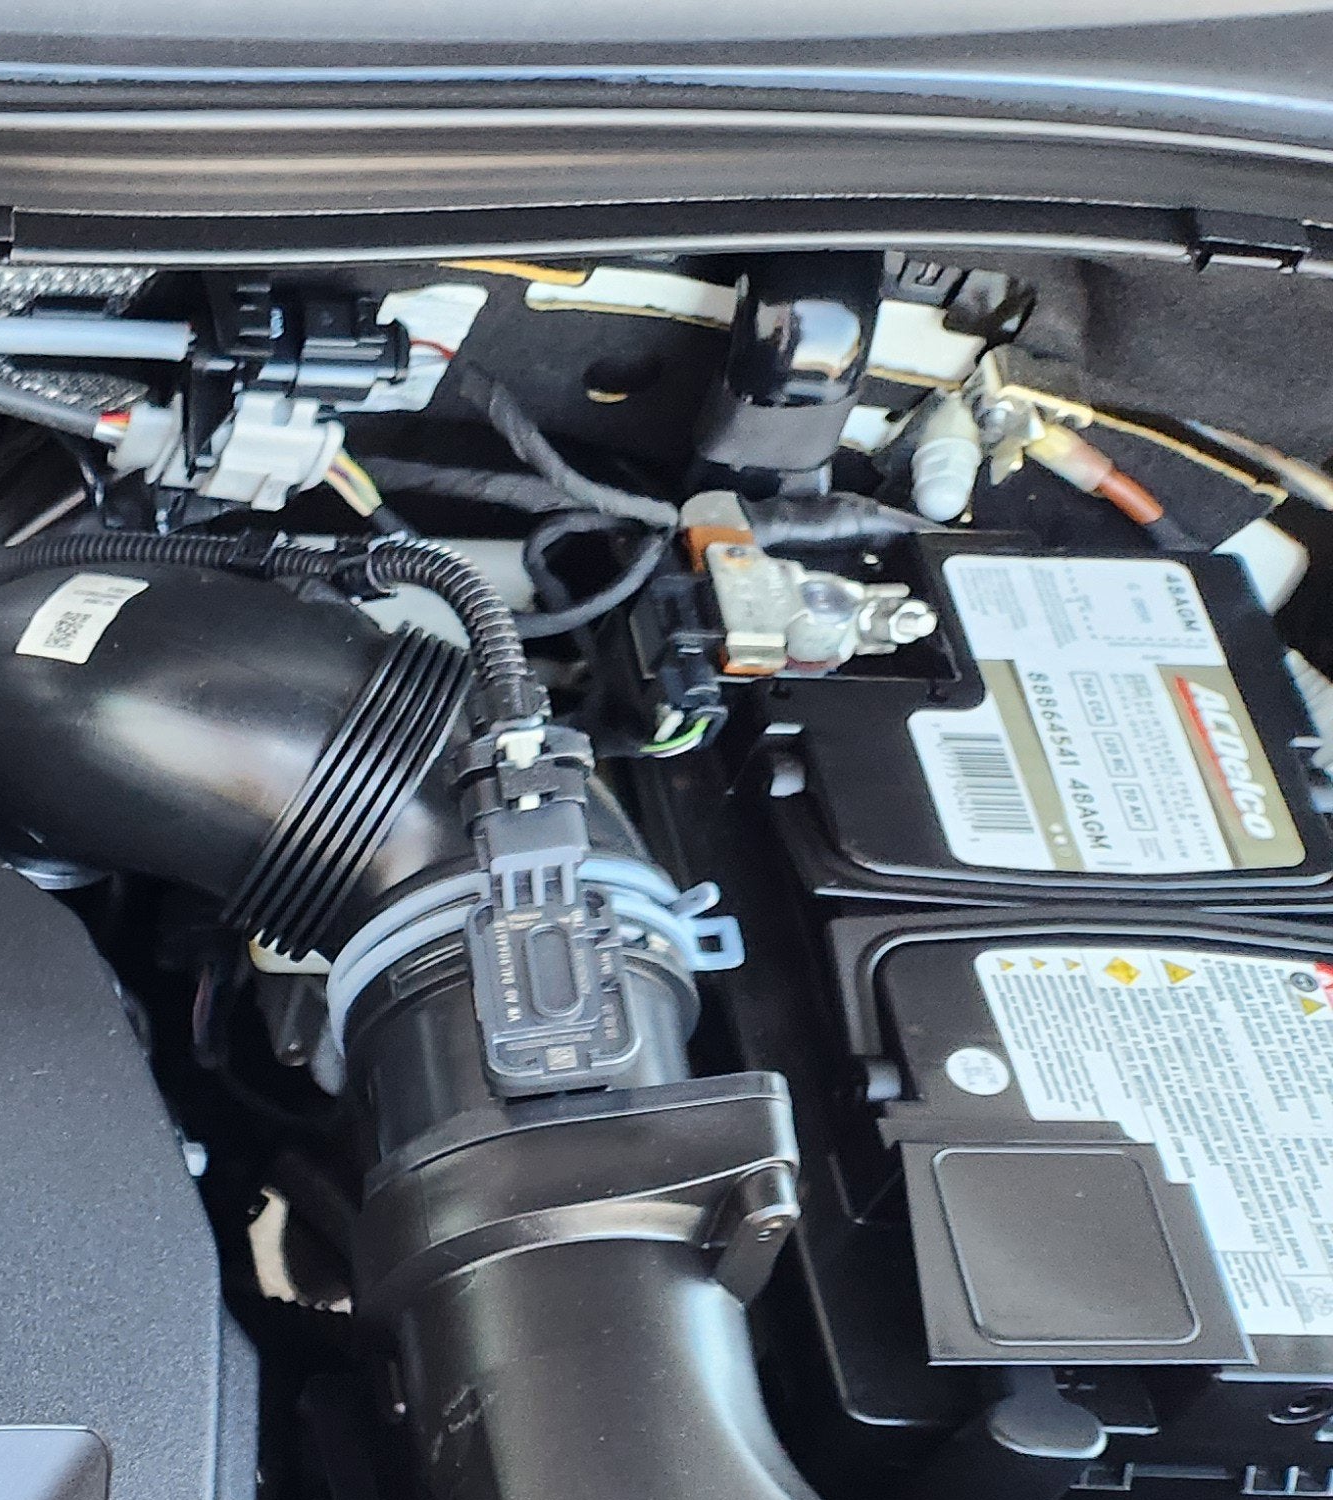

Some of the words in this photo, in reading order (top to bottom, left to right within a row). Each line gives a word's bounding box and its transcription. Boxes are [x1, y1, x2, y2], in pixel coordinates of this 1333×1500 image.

[1165, 573, 1203, 633] 48AGM
[1027, 670, 1081, 768] 88864541
[1067, 777, 1113, 851] 48AGM
[1087, 700, 1108, 722] CCA
[1188, 681, 1277, 841] ACDelco
